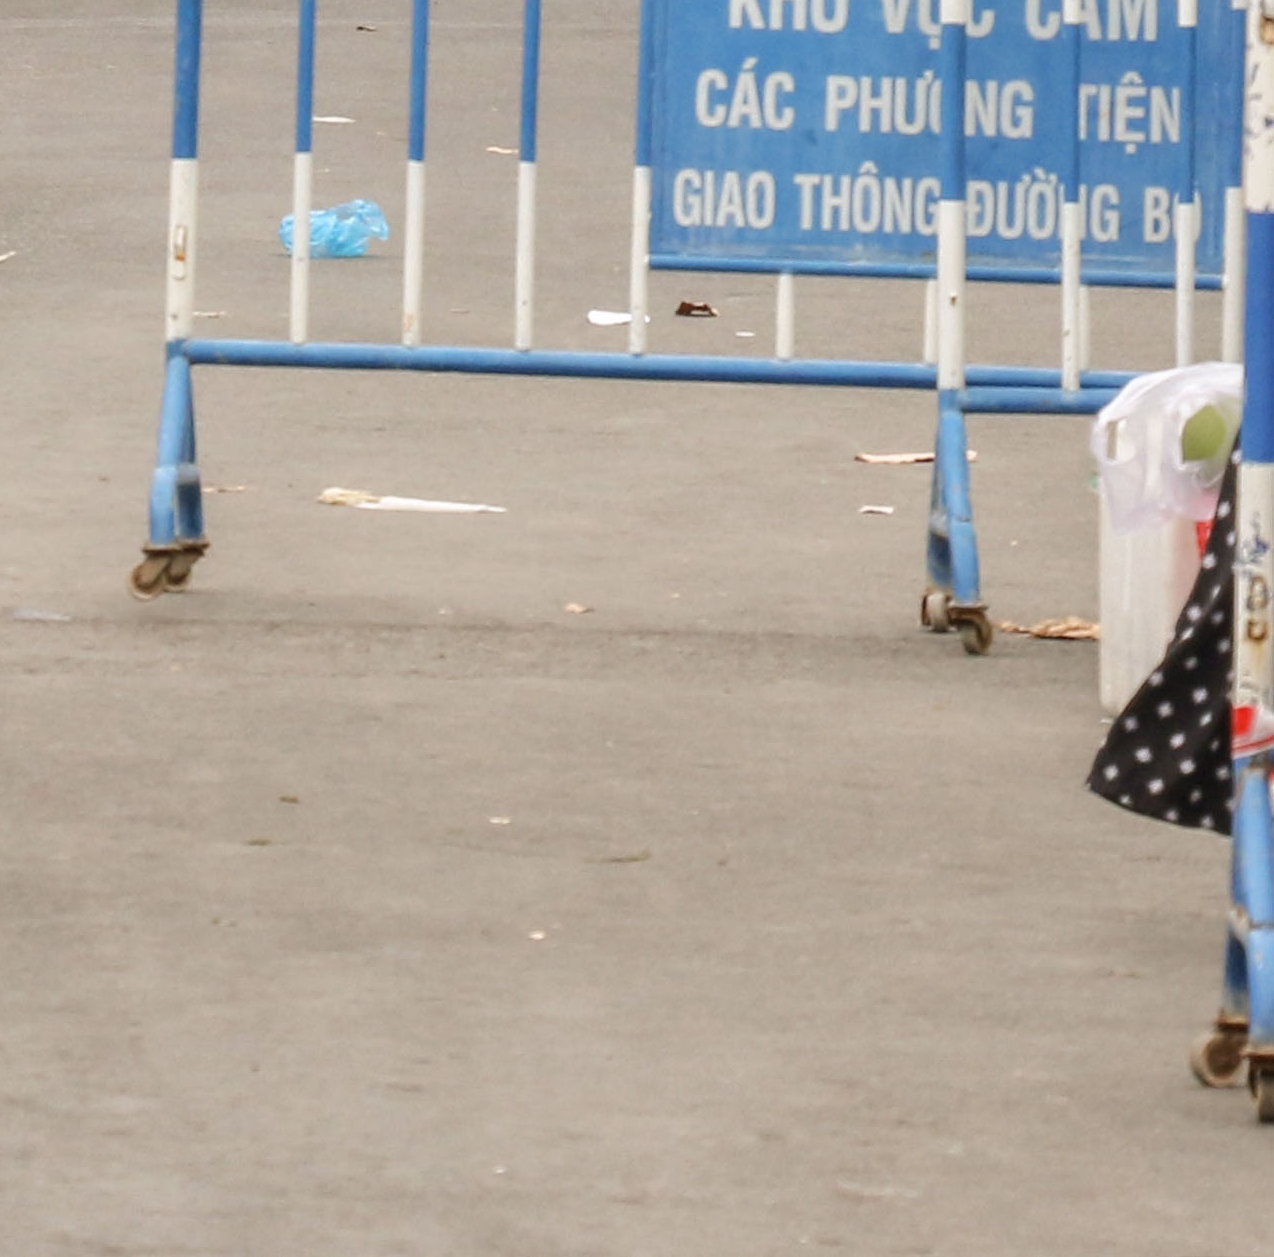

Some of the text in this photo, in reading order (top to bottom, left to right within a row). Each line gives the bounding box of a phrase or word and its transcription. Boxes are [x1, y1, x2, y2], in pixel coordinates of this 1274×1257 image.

[695, 57, 796, 131] CÁC
[672, 168, 775, 231] GIAO
[793, 160, 940, 237] THÔNG
